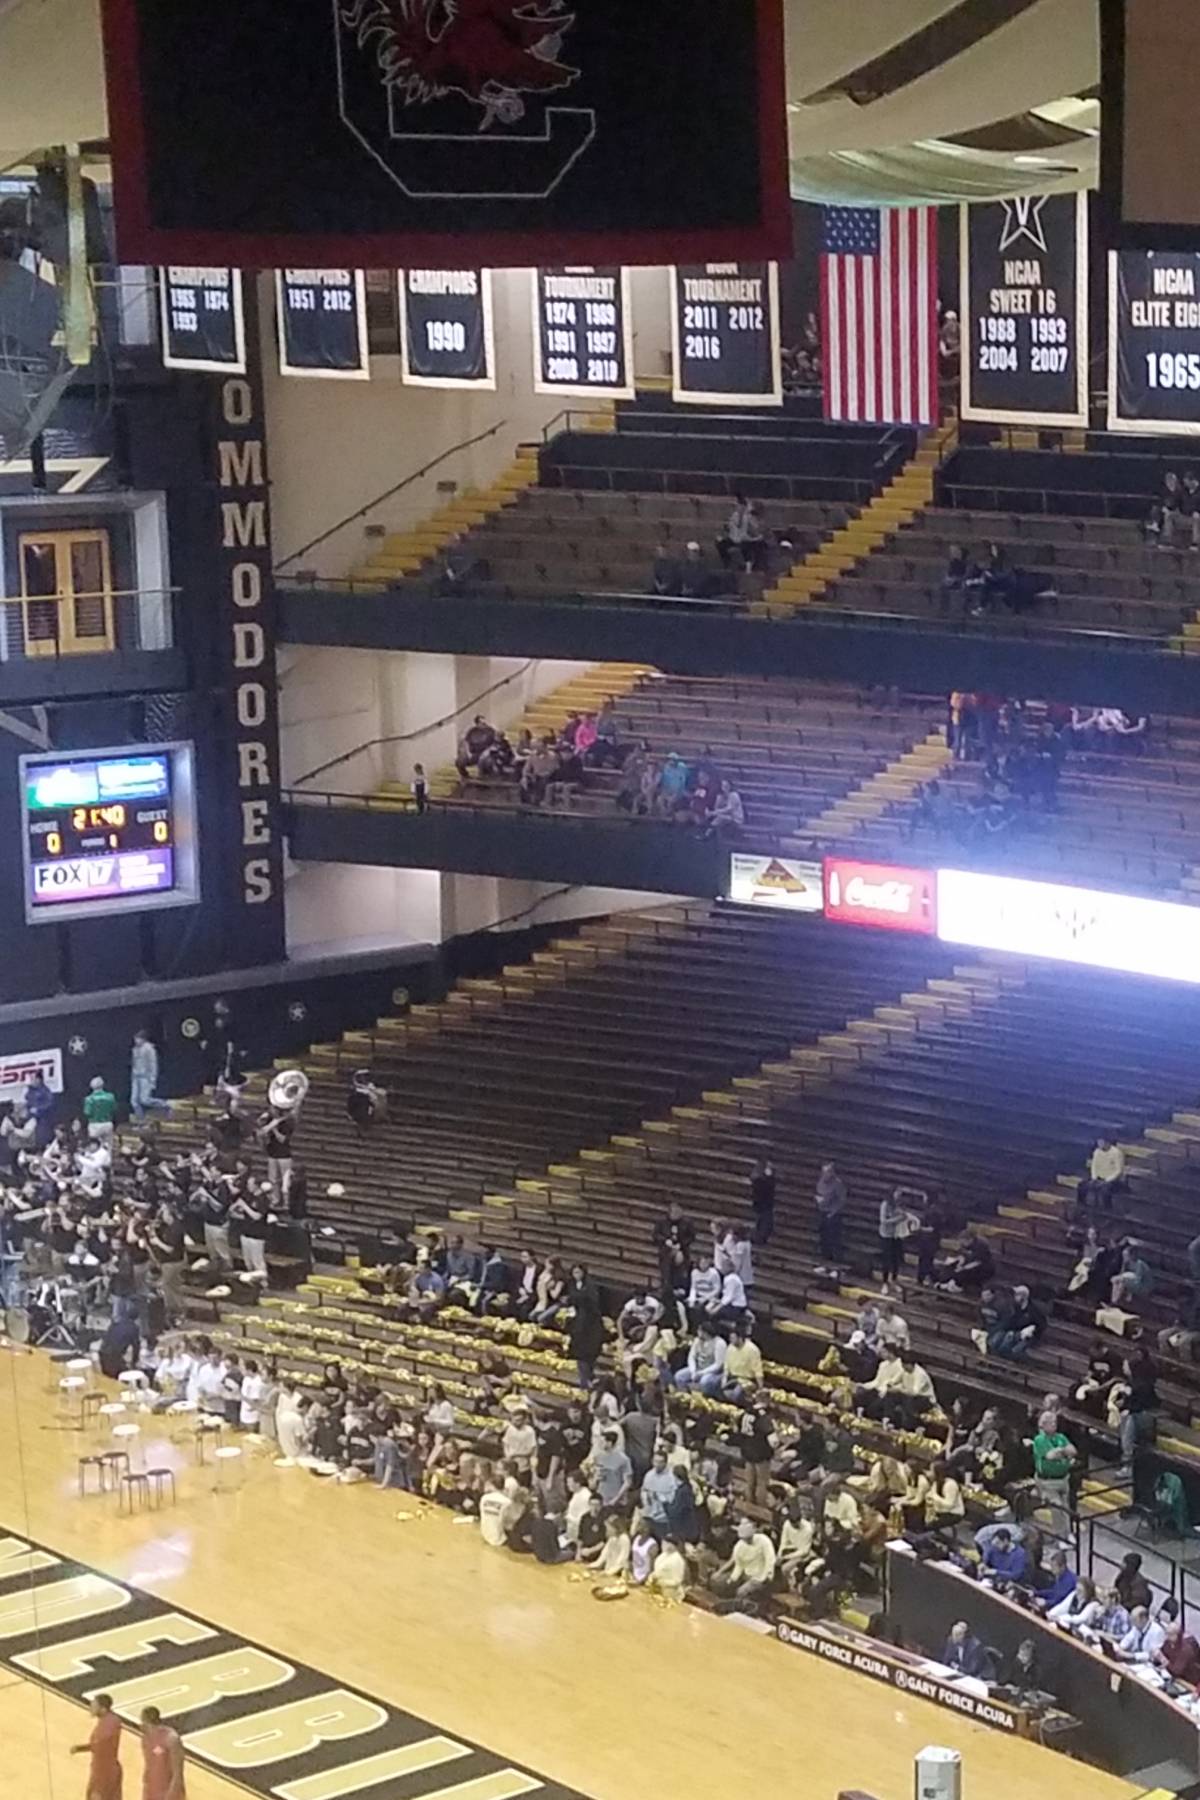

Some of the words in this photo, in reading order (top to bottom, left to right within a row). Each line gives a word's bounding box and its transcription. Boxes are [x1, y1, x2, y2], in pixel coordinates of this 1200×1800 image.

[1004, 259, 1041, 286] NCAA
[1153, 268, 1195, 296] NCAA
[544, 276, 616, 300] TOURNAMENT
[683, 278, 762, 302] TOURNAMENT
[990, 288, 1032, 314] SWEET
[1037, 288, 1056, 315] 16
[684, 305, 718, 330] 2011
[728, 306, 764, 330] 2012
[1131, 300, 1171, 327] ELITE
[426, 321, 465, 352] 1990
[1030, 317, 1067, 344] 1993
[685, 335, 721, 360] 2016
[979, 345, 1018, 372] 2004
[1030, 346, 1069, 373] 2007
[218, 379, 273, 904] OMMODORES
[46, 832, 61, 853] 0
[154, 821, 168, 842] 0
[38, 863, 83, 889] FOX
[0, 1059, 54, 1084] SPN
[789, 1628, 818, 1651] GARY
[819, 1640, 852, 1664] FORCE
[854, 1655, 890, 1679] ACURA
[908, 1676, 937, 1699] GARY
[939, 1688, 975, 1712] FORCE
[976, 1702, 1015, 1729] ACURA
